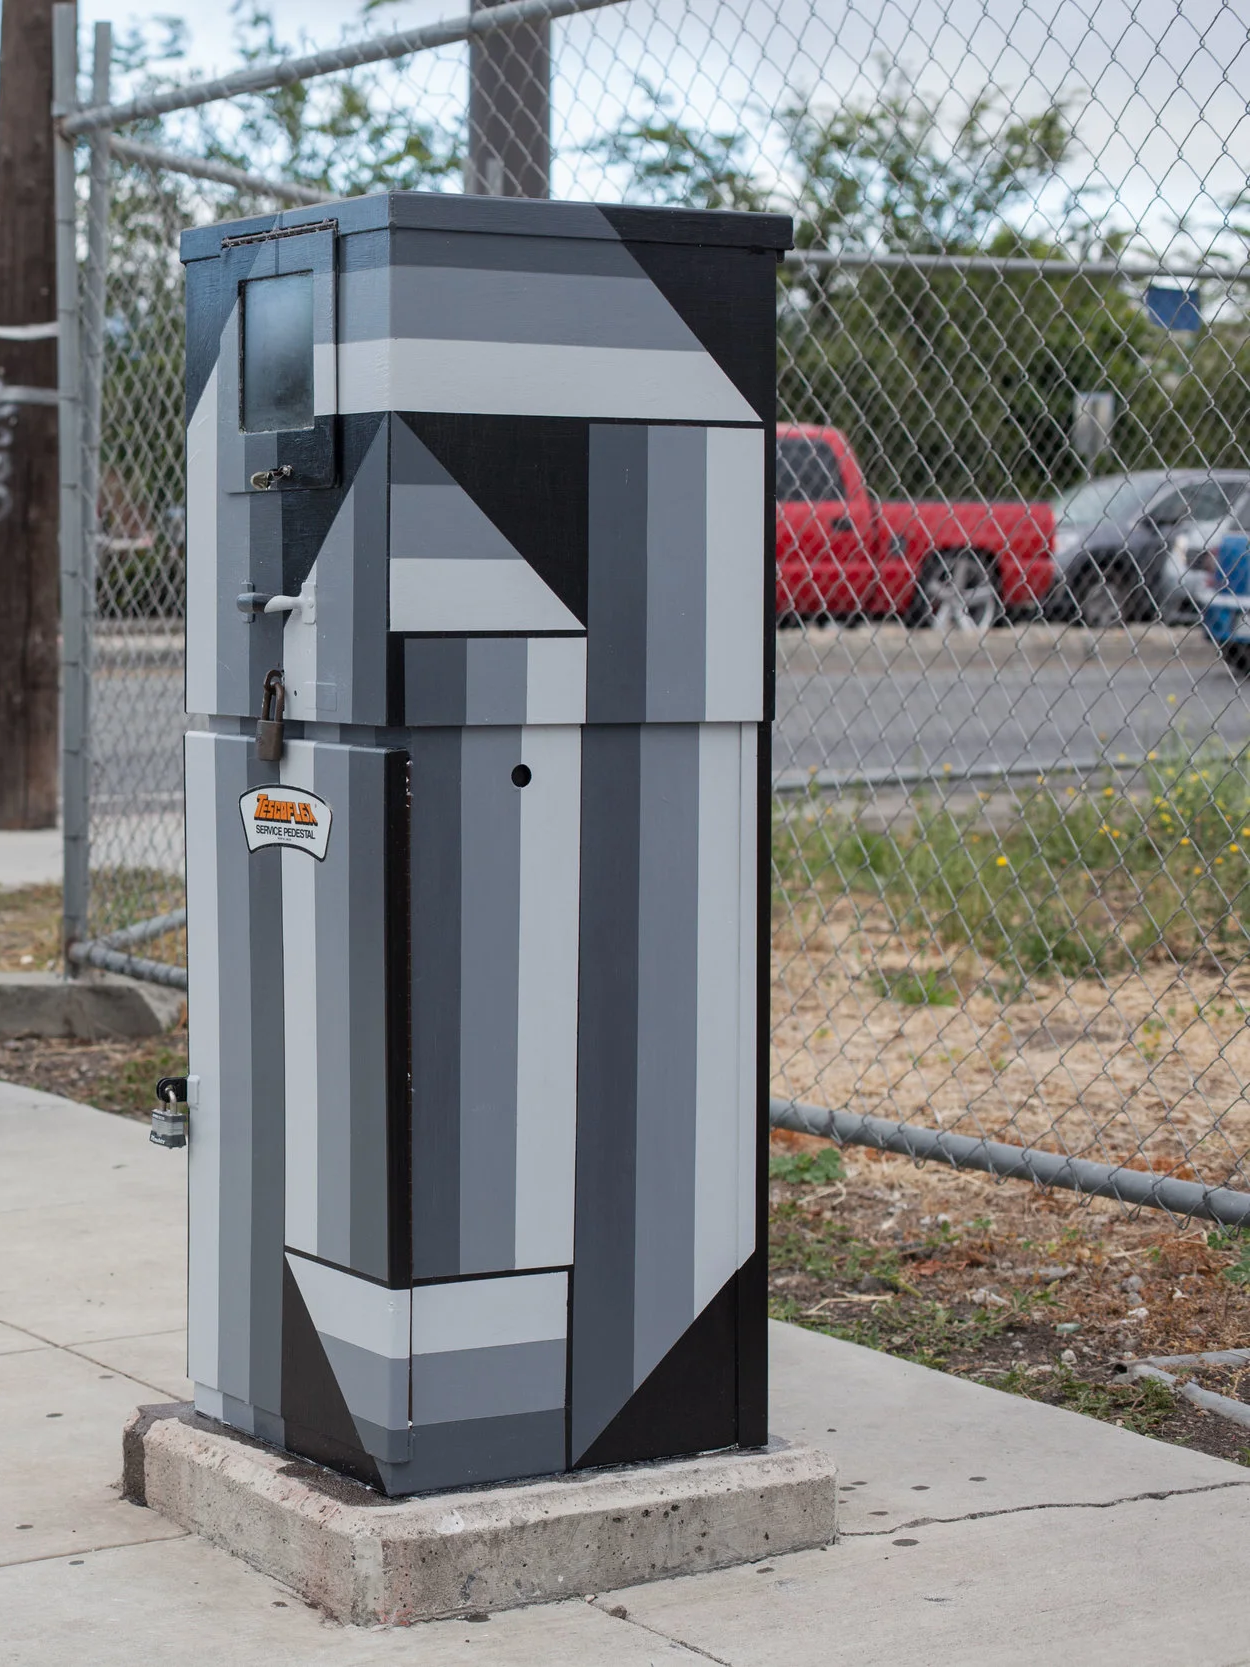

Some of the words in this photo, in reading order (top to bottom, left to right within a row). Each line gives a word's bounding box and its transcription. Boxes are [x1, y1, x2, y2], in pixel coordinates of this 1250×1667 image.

[254, 794, 318, 826] TESCOFLEX
[256, 825, 282, 836] SERVICE
[284, 827, 316, 839] PEDESTAL
